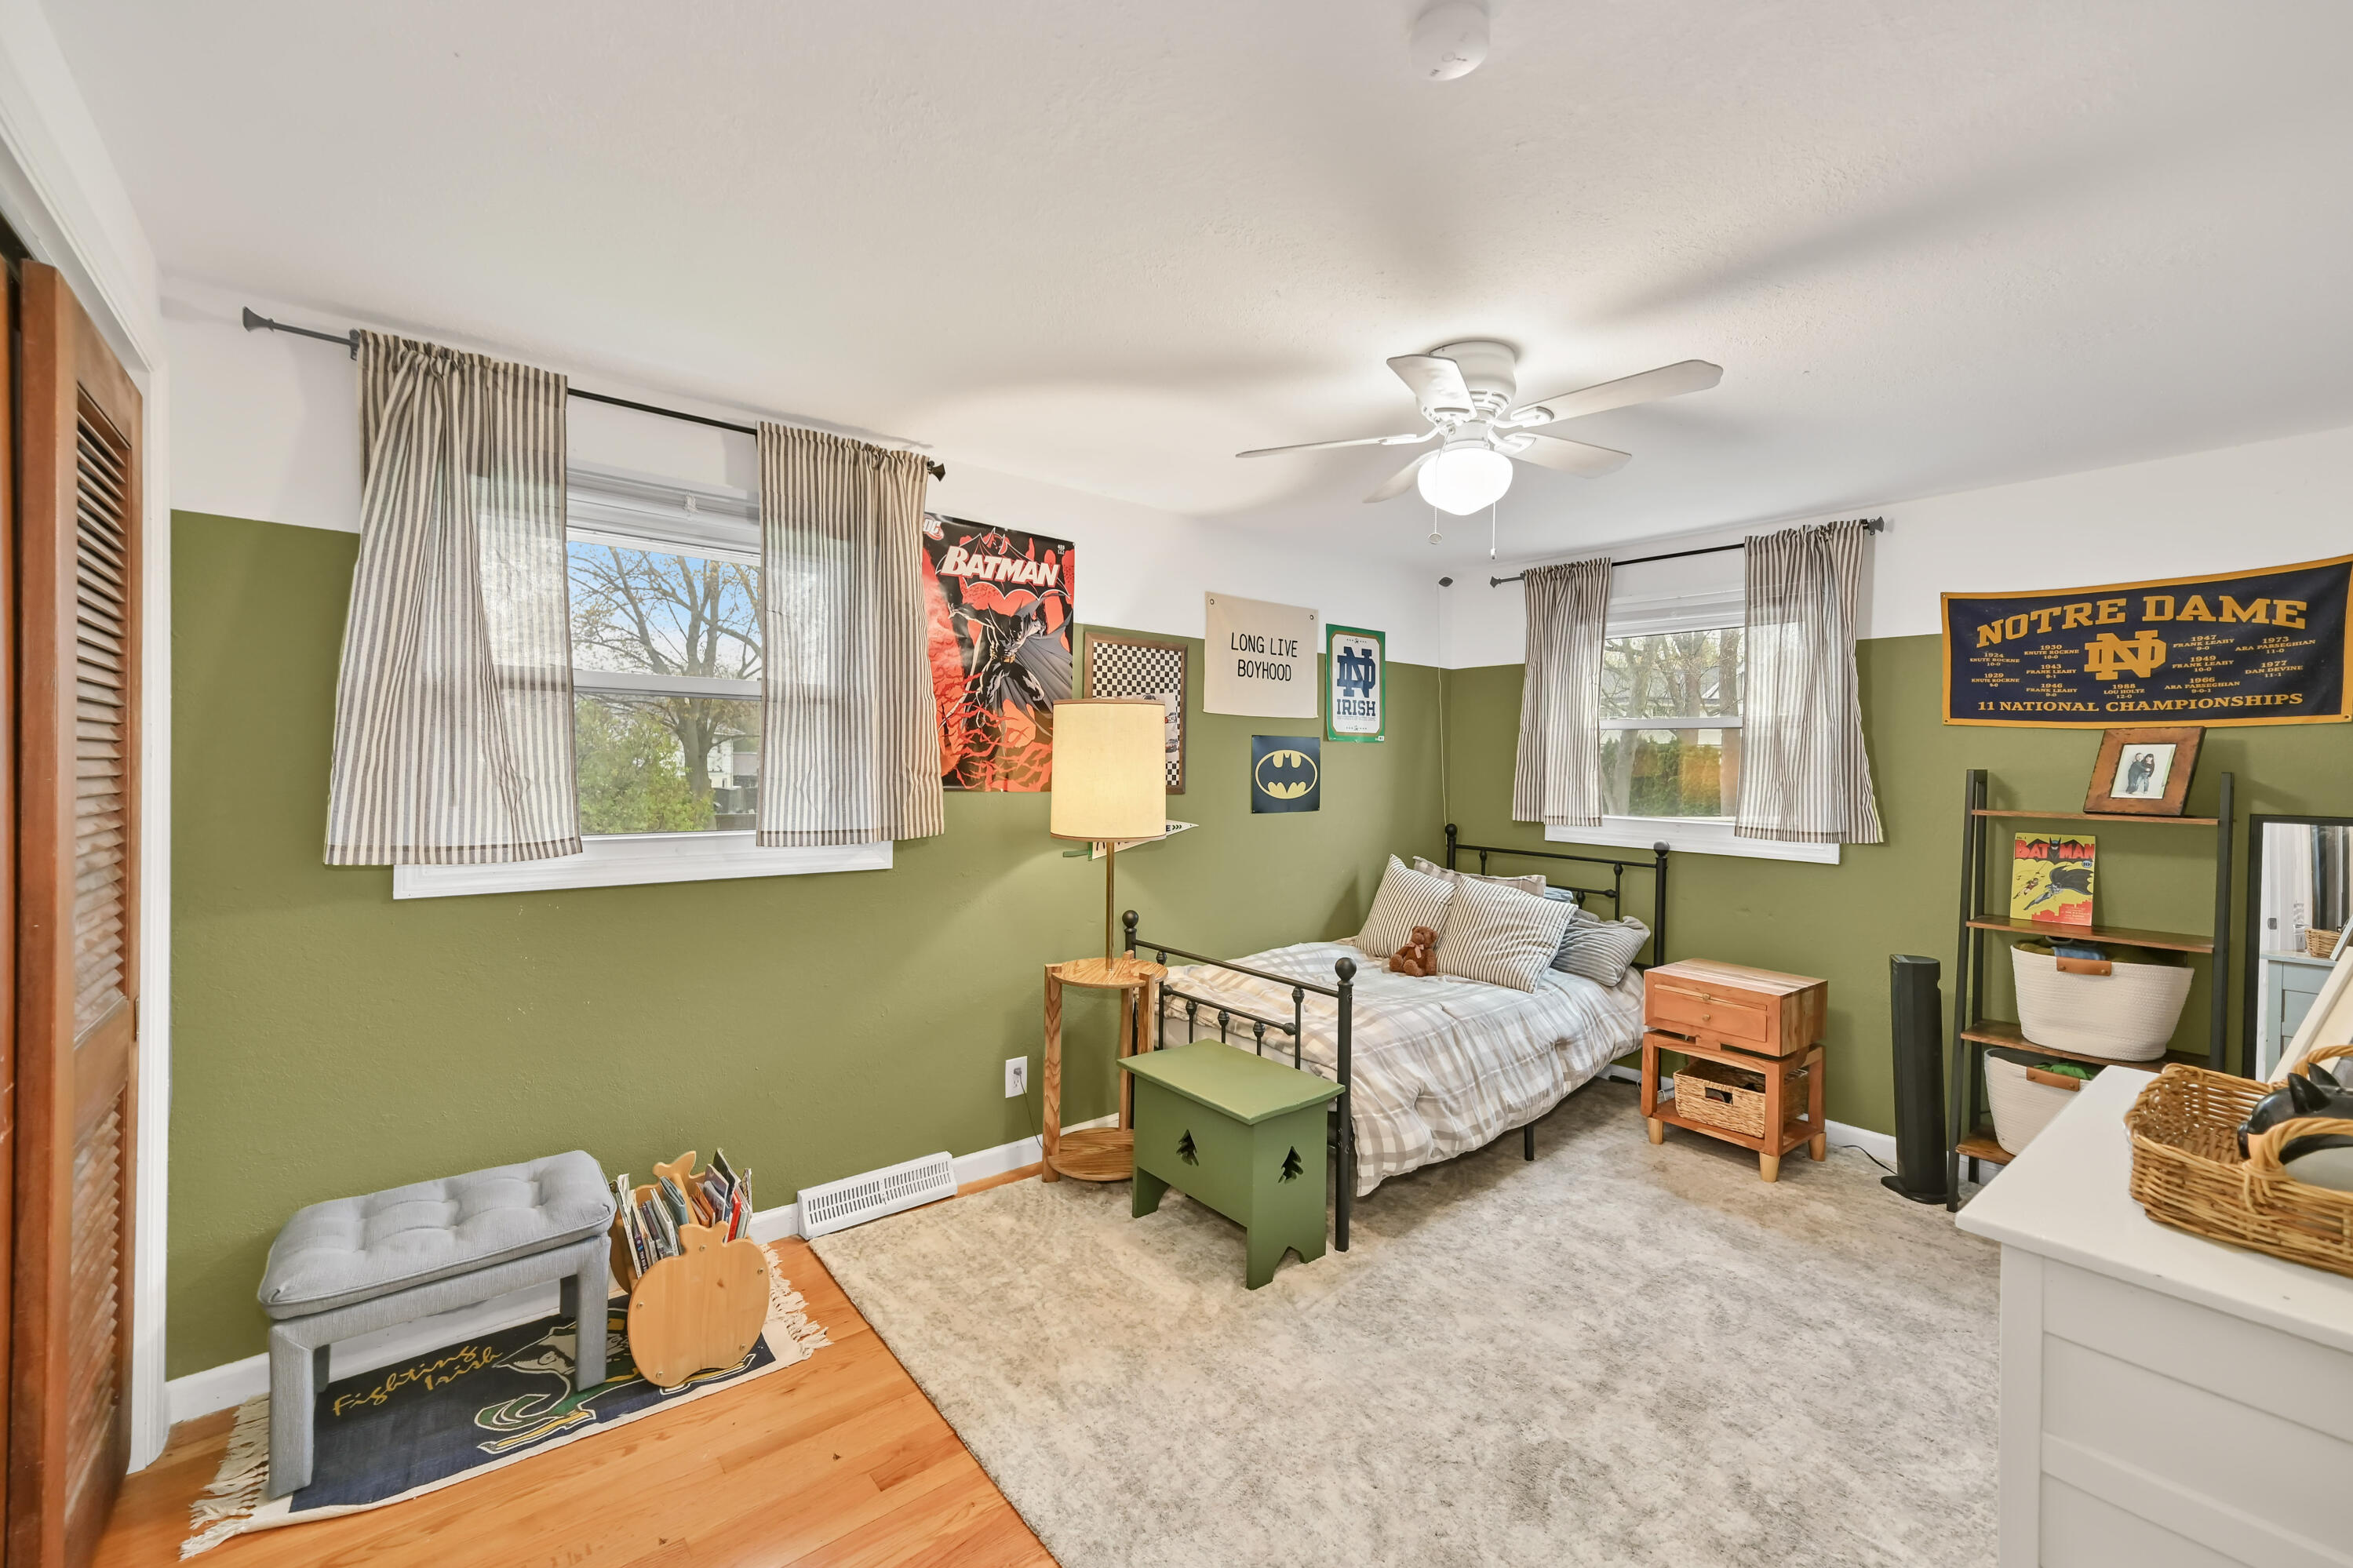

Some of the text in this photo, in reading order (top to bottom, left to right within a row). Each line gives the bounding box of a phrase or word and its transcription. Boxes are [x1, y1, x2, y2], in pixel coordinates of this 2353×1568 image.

[923, 518, 942, 534] DC
[940, 545, 1061, 588] BATMAN
[1976, 595, 2307, 648] NOTRE DAME
[1231, 631, 1299, 657] LONG LIVE
[2256, 639, 2316, 649] PARSEGHIAN
[1237, 659, 1292, 682] BOYHOOD
[1337, 646, 1376, 698] ND
[1336, 699, 1376, 716] IRISH
[1978, 693, 2304, 713] 11 NATIONAL CHAMPIONSHIPS
[332, 1345, 478, 1417] Fighting
[424, 1346, 503, 1391] Irish
